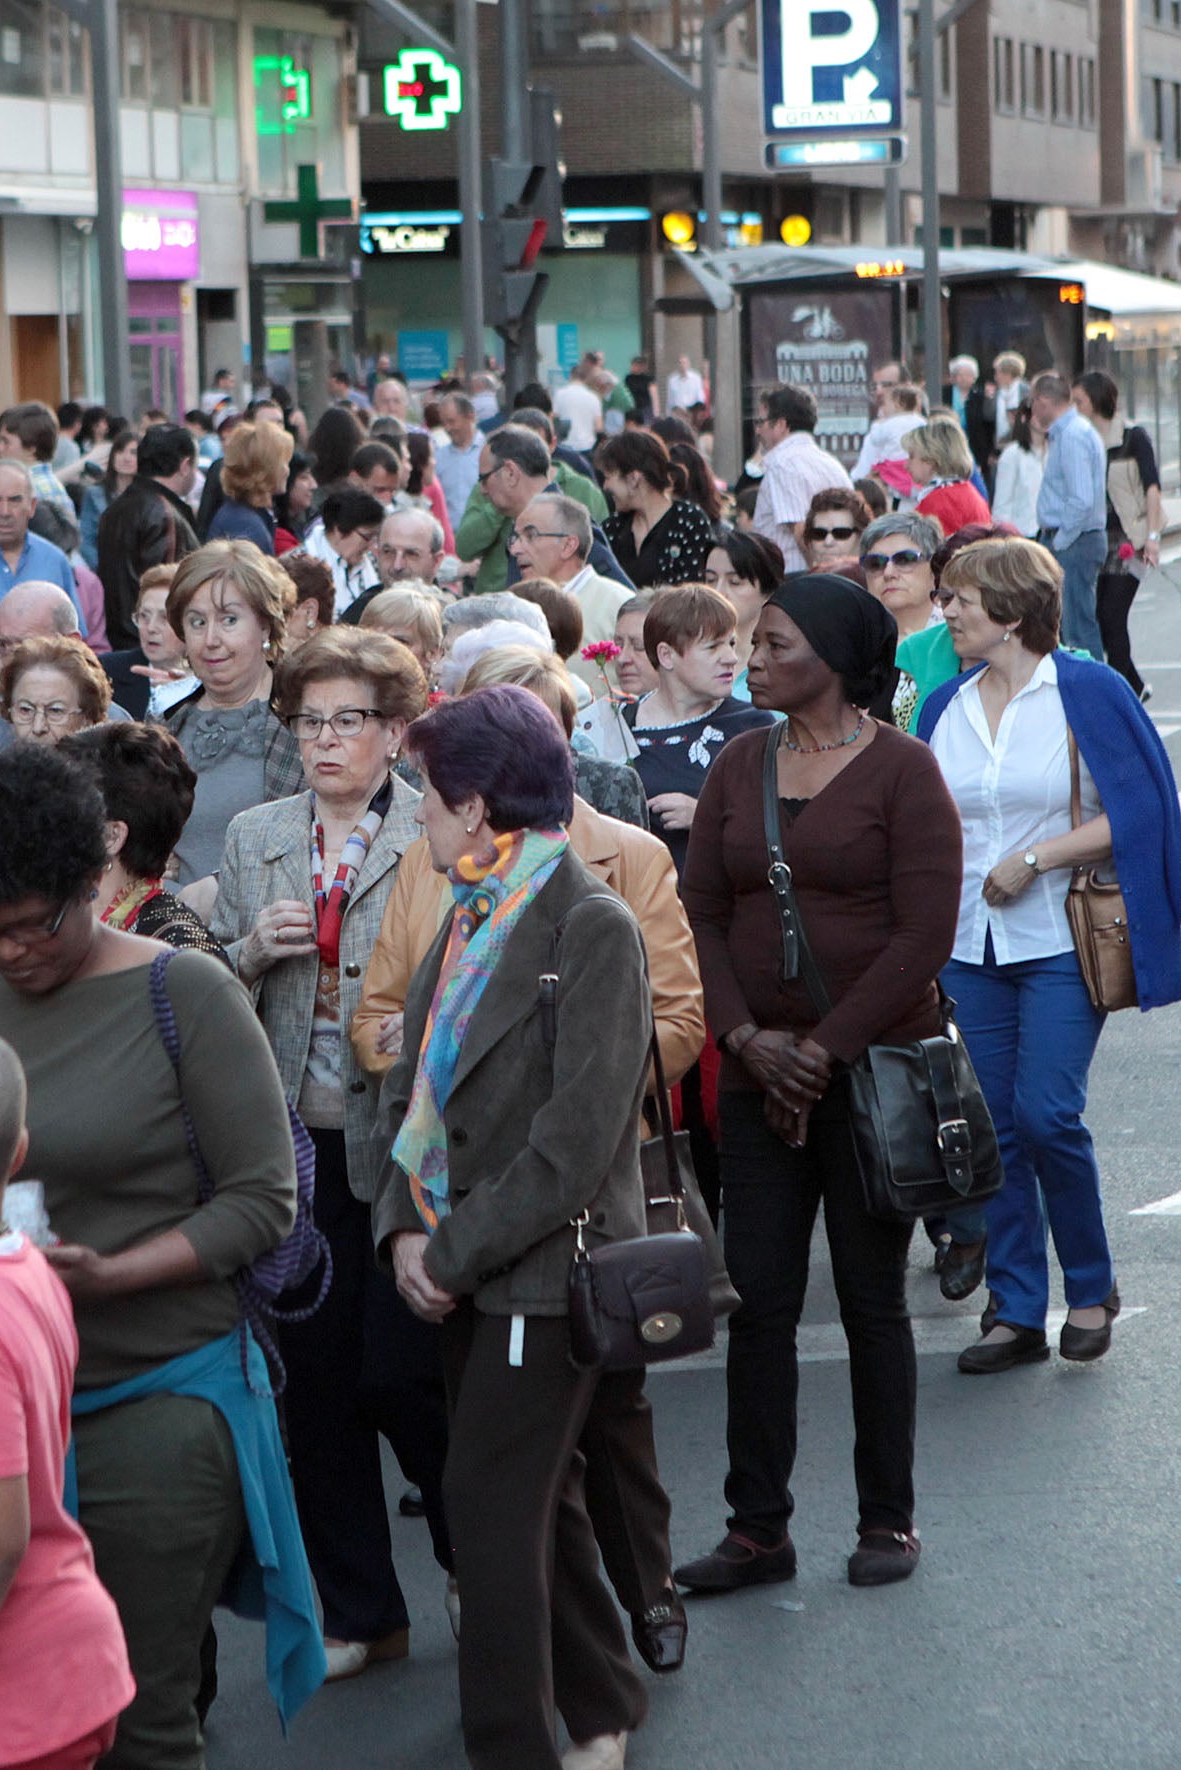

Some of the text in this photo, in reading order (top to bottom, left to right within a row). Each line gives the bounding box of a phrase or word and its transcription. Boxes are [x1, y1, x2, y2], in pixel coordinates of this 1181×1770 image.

[781, 0, 879, 106] P
[777, 363, 868, 384] UNA BODA
